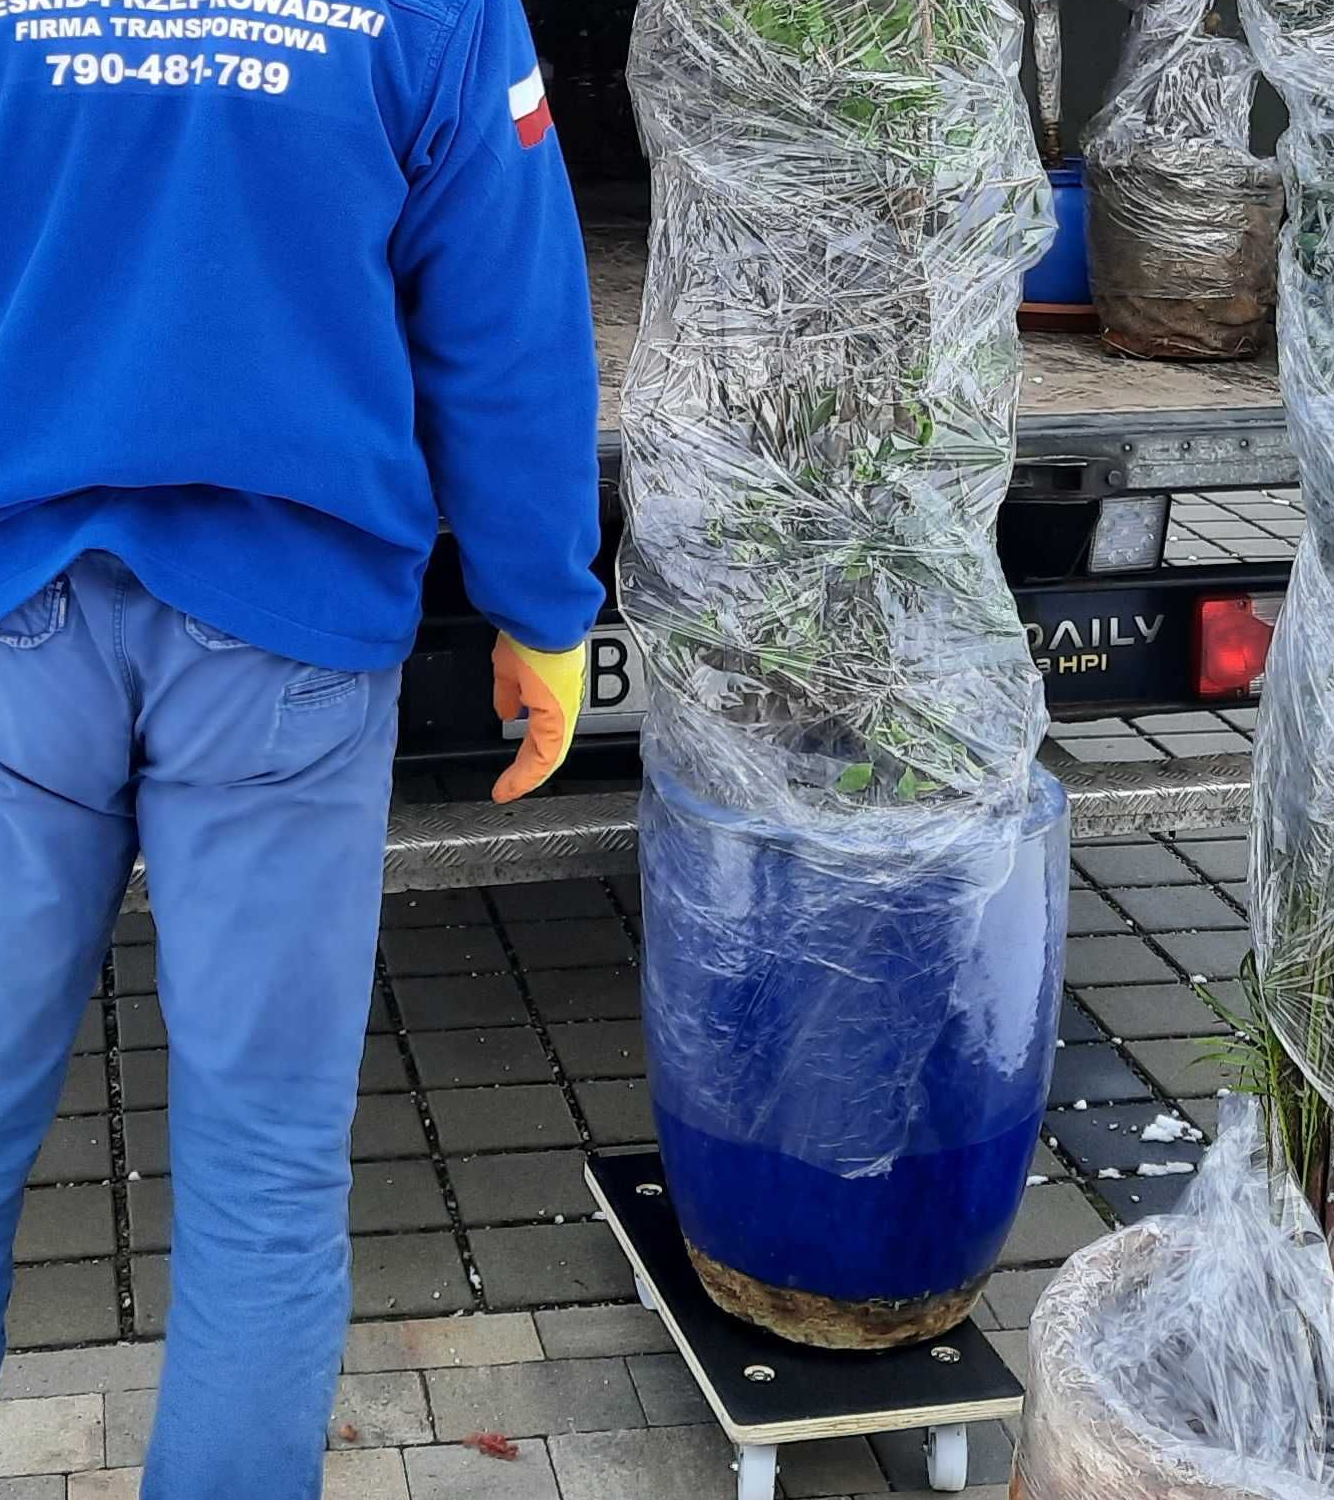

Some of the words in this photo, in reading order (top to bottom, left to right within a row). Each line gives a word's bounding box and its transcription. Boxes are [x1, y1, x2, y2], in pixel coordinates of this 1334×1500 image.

[15, 16, 103, 41] FIRMA
[110, 16, 328, 54] TRANSPORTOWA
[45, 53, 290, 95] 790-481-789
